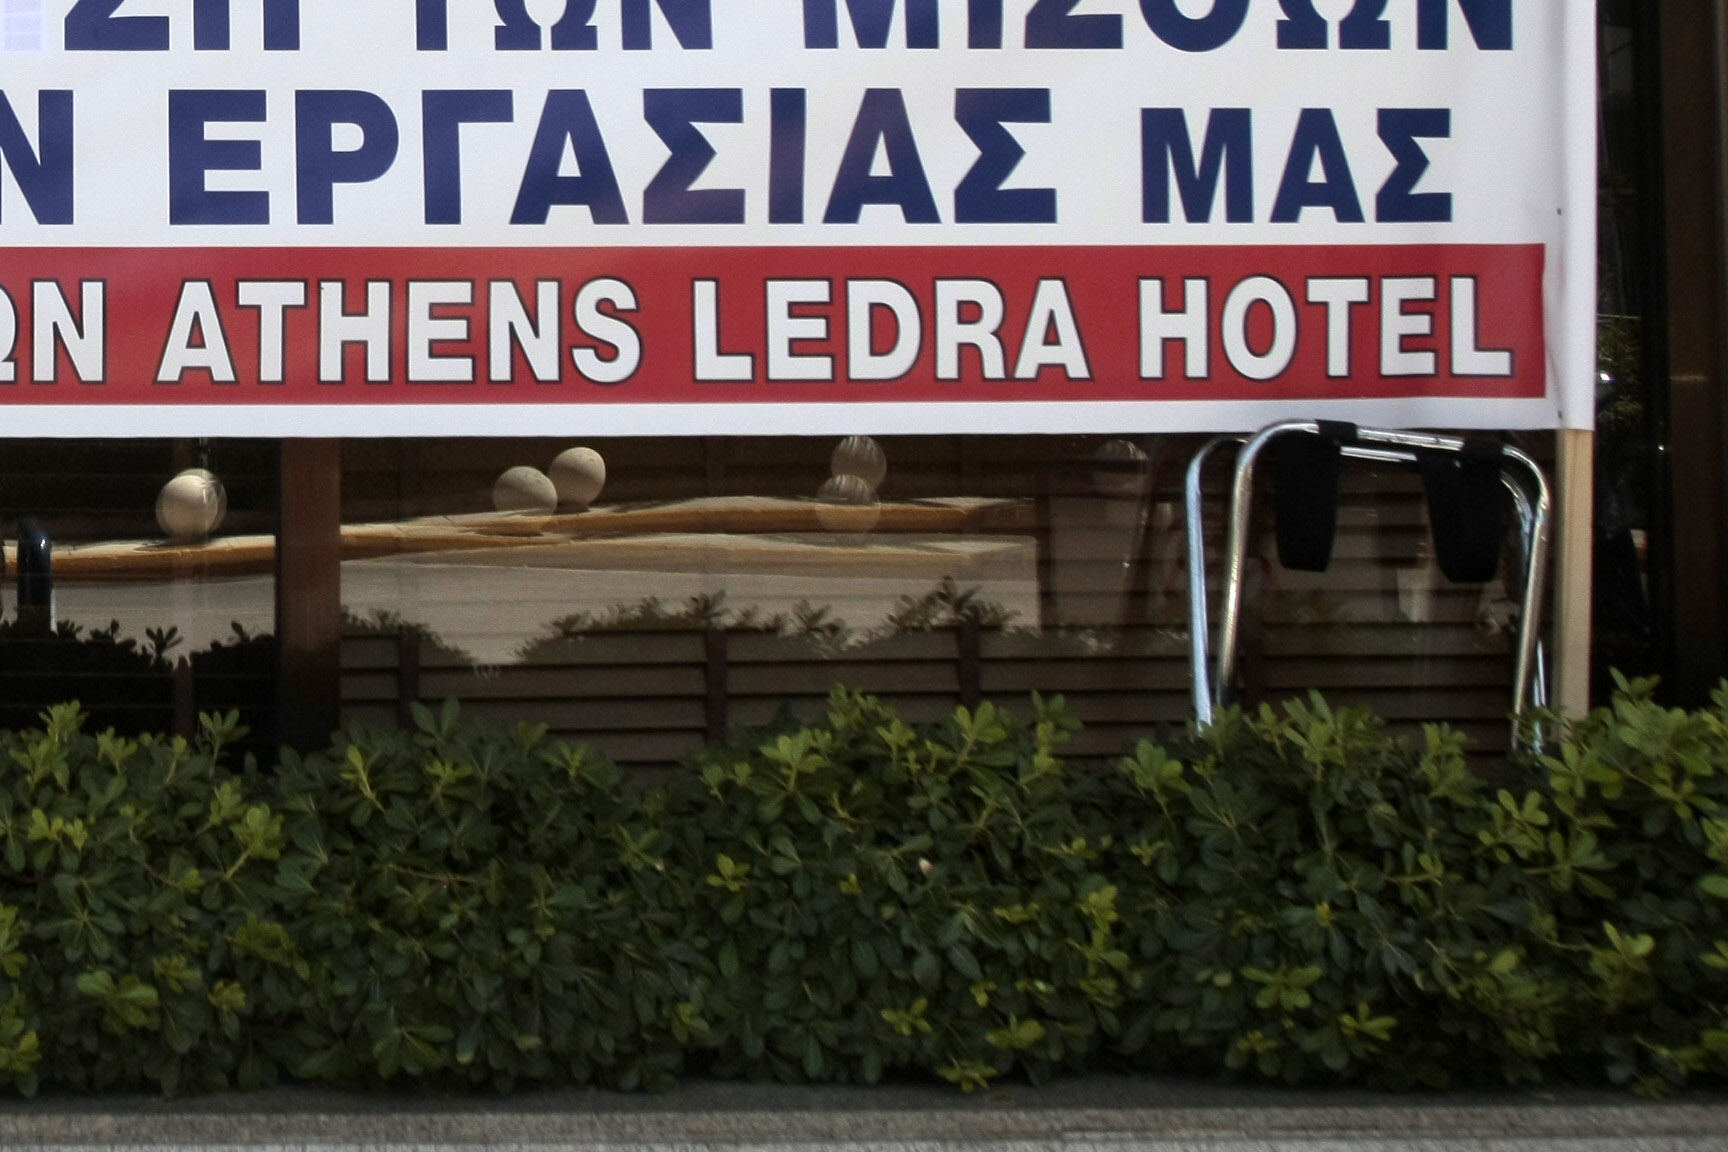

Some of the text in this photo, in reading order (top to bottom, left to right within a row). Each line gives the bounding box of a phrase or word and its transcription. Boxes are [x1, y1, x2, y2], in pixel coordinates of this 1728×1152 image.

[169, 88, 1057, 226] ΕΡΓΑΣΙΑΣ
[1144, 107, 1453, 224] ΜΑΣ
[156, 279, 641, 384] ATHENS
[693, 279, 1091, 381] LEDRA
[1139, 276, 1511, 380] HOTEL
